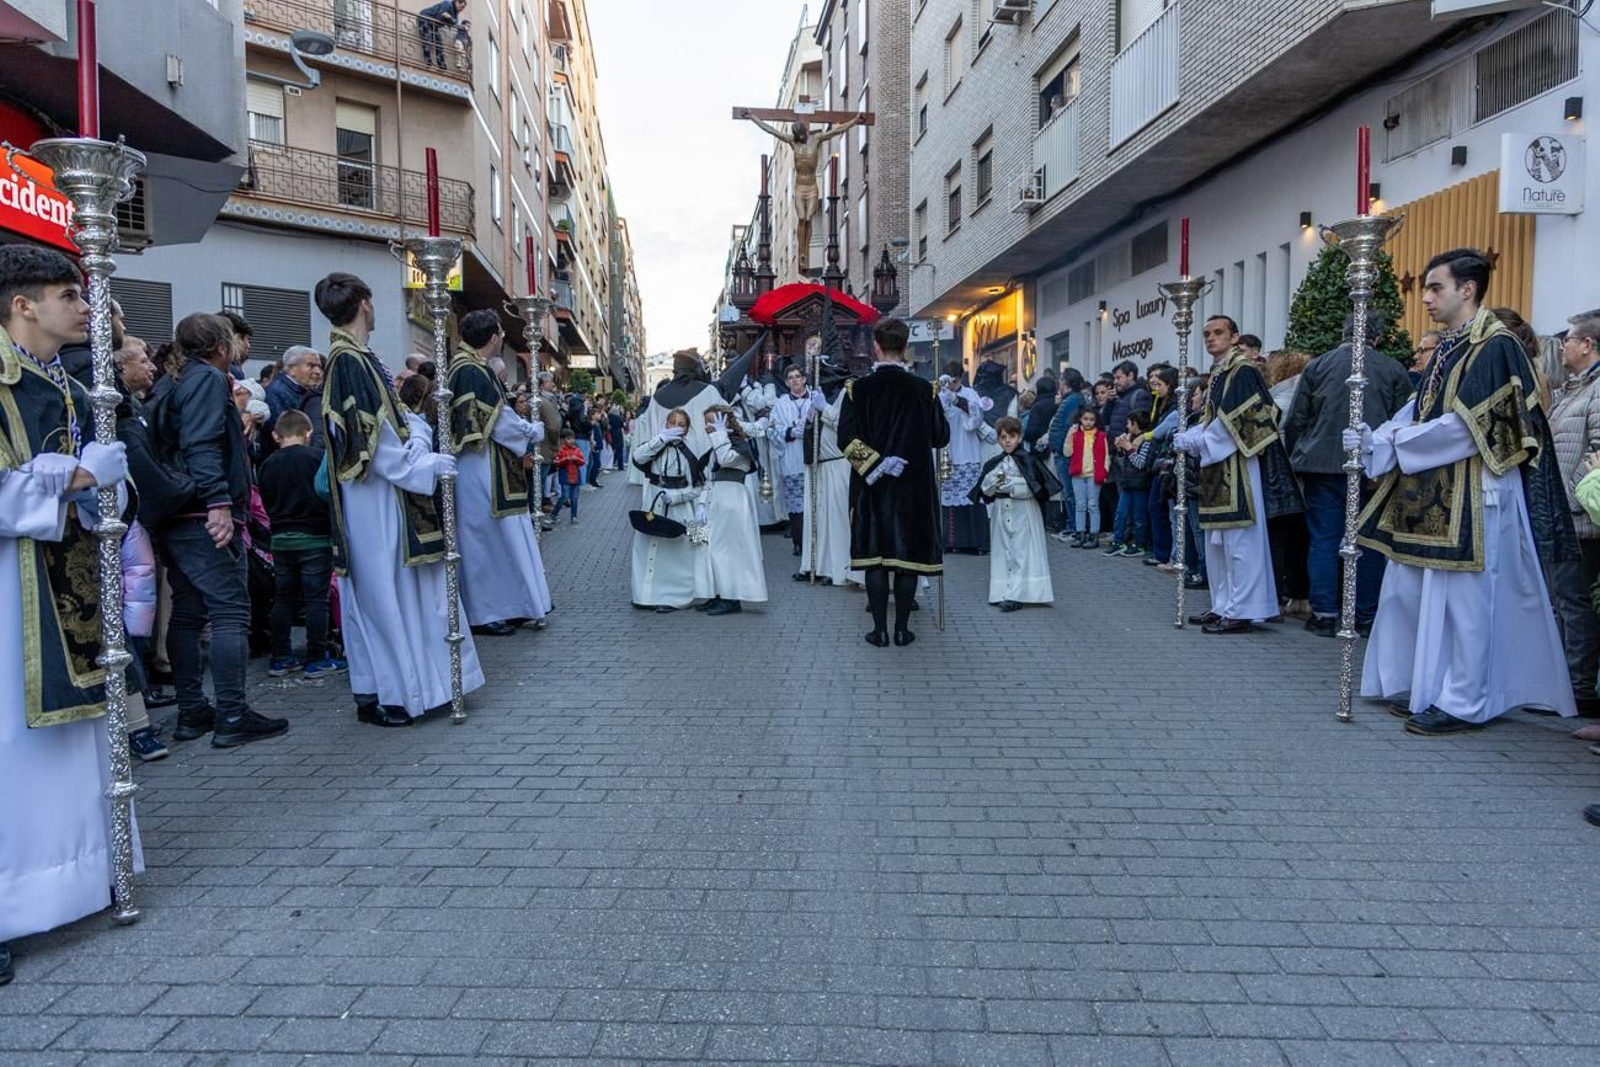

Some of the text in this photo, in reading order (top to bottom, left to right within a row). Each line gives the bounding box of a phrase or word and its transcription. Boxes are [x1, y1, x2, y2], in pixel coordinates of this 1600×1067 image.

[1112, 296, 1167, 332] Spa Luxury
[1112, 337, 1153, 361] Massage
